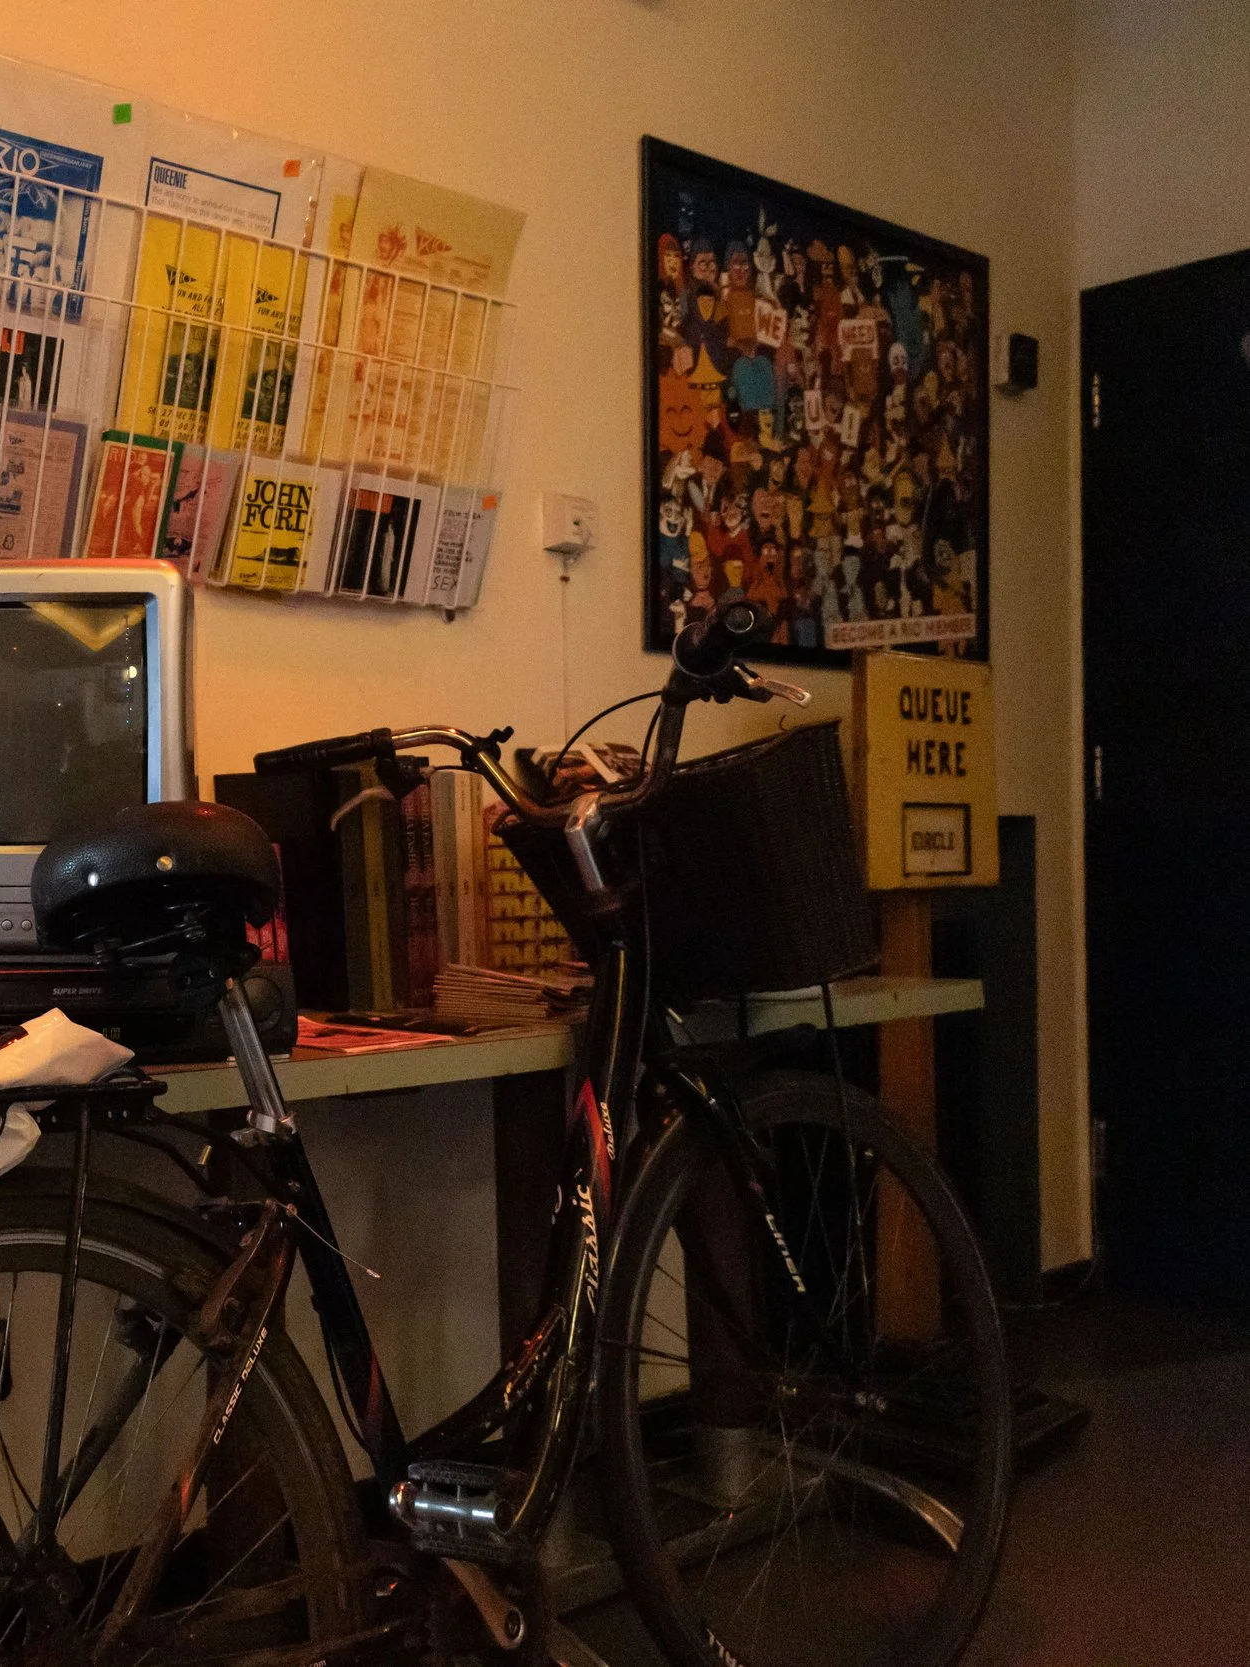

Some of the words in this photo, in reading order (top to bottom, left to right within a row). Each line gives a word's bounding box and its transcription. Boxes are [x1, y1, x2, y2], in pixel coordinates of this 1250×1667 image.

[153, 165, 188, 190] QUEENIE
[246, 480, 316, 509] JOHN
[430, 575, 458, 591] SEX
[899, 685, 972, 725] QUEUE
[907, 739, 967, 777] HERE
[213, 1382, 243, 1445] CLASSIC
[241, 1326, 268, 1381] DELUXE
